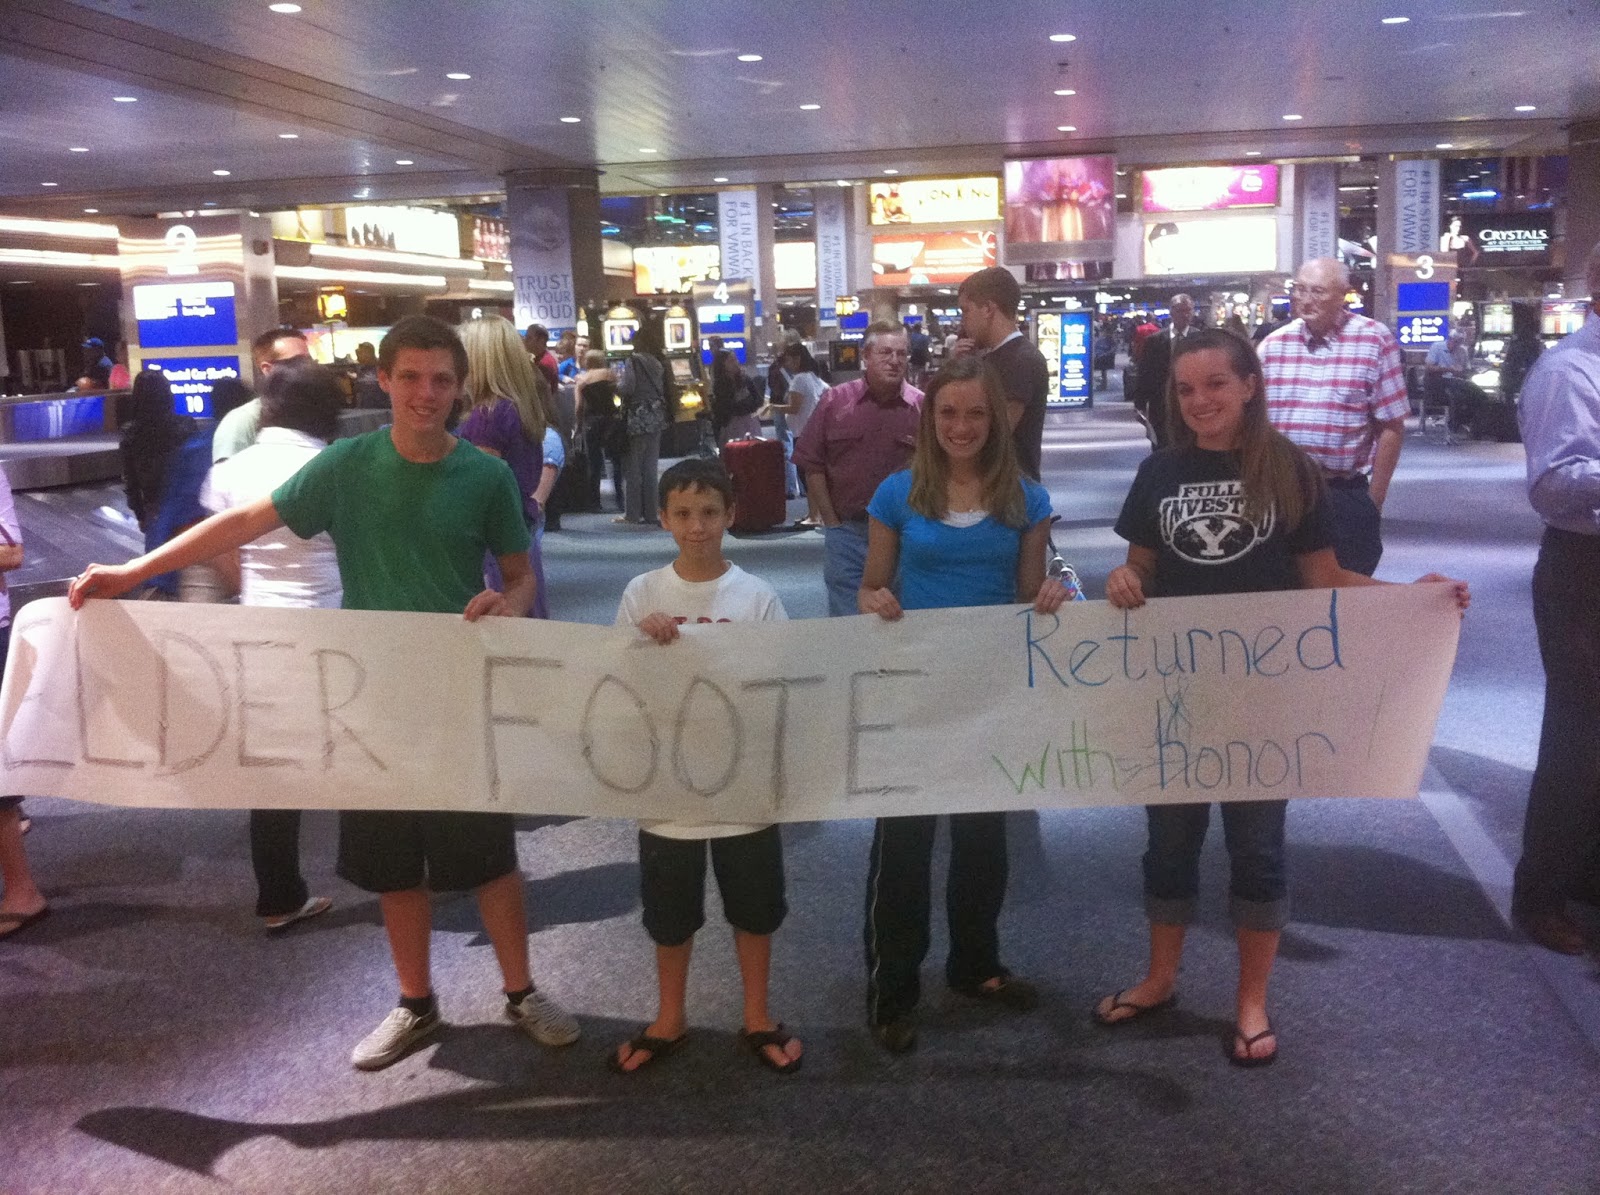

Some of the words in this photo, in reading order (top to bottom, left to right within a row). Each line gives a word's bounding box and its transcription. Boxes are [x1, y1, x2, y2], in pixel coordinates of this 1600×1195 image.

[1403, 169, 1418, 198] FOR
[725, 201, 737, 228] FOR
[740, 222, 752, 236] IN
[1479, 229, 1549, 241] CRYSTALS
[1416, 255, 1434, 279] 3
[517, 274, 570, 290] TRUST
[713, 282, 729, 303] 4
[517, 292, 531, 305] IN
[535, 290, 572, 304] YOUR
[519, 304, 573, 320] CLOUD
[185, 395, 204, 413] 10
[1182, 483, 1241, 498] FULL
[1186, 519, 1241, 556] Y
[1016, 588, 1345, 688] Returned
[2, 618, 388, 777] ELDER
[484, 655, 930, 812] FOOTE
[1155, 699, 1337, 791] honor
[991, 719, 1119, 794] with
